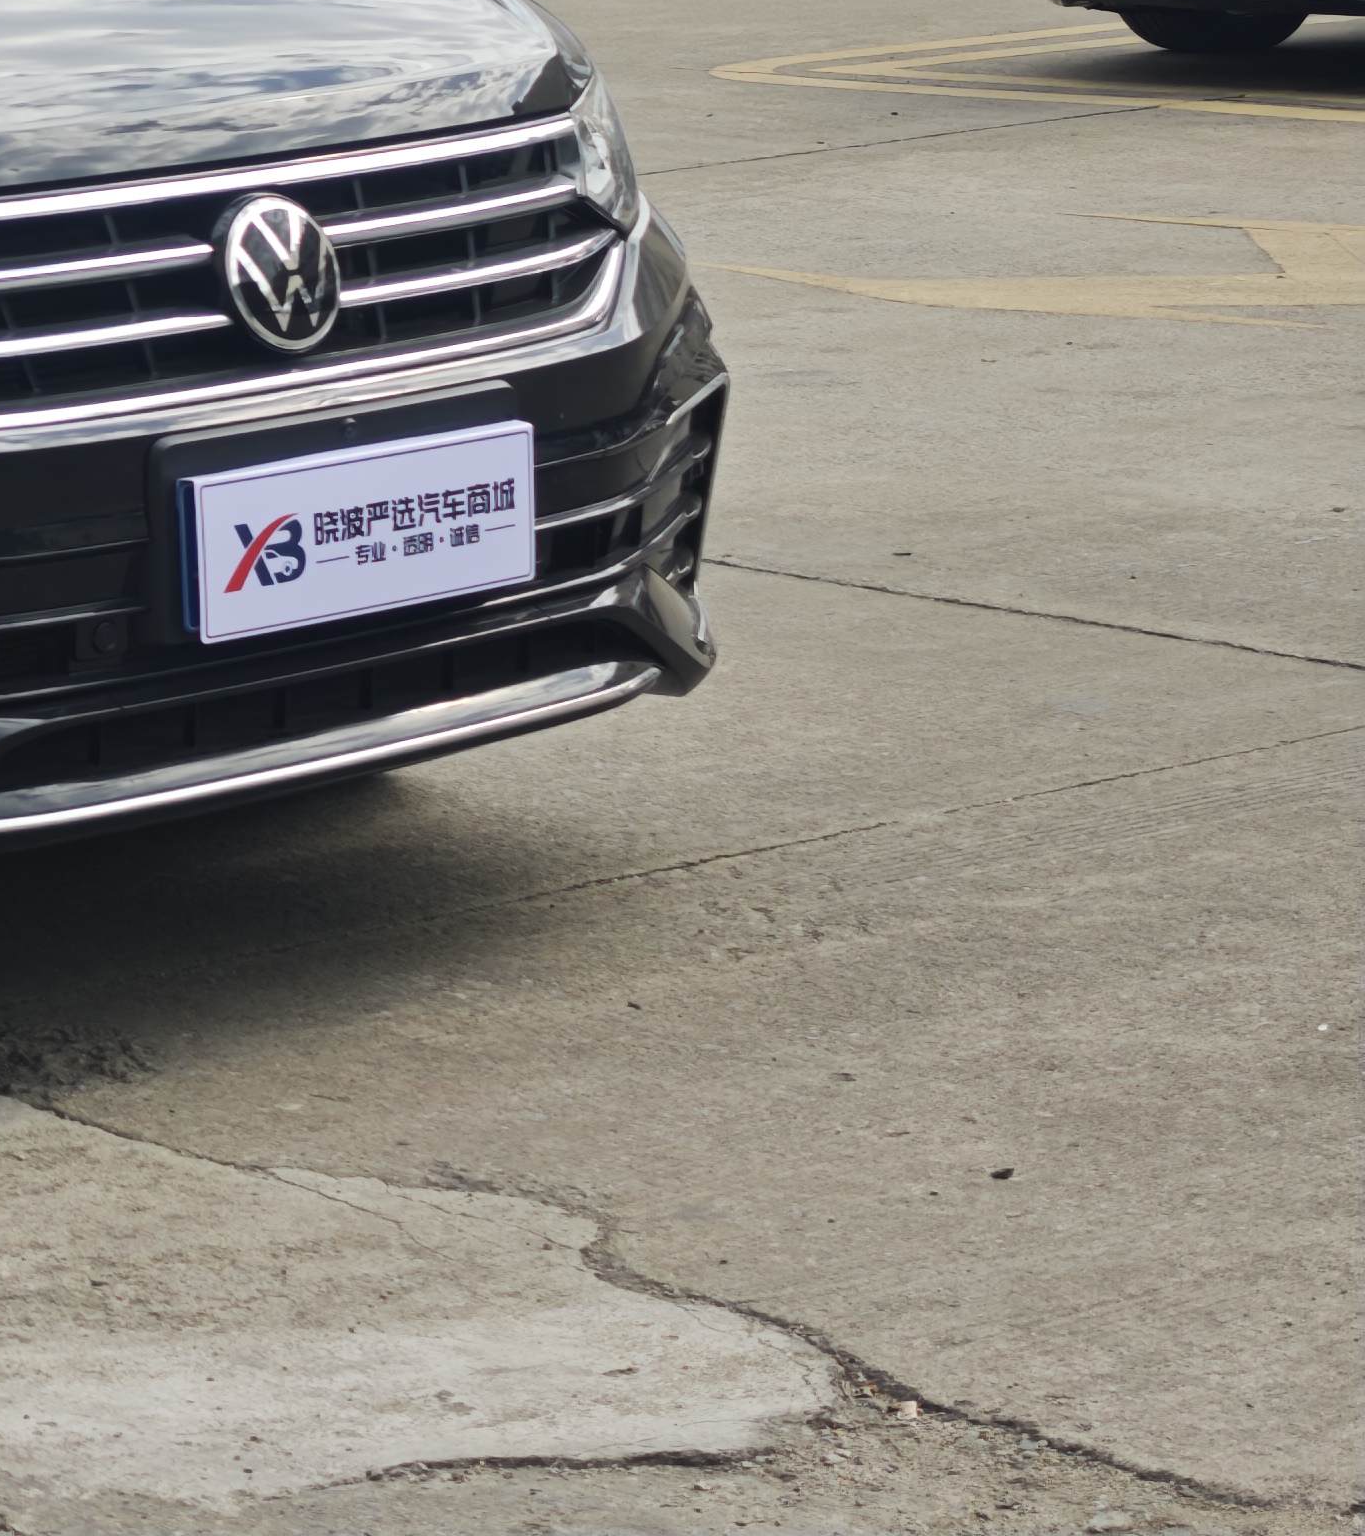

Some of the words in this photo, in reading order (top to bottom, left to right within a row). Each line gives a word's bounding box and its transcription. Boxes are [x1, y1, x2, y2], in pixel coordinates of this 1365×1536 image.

[313, 477, 515, 546] 晓波严选汽车商城
